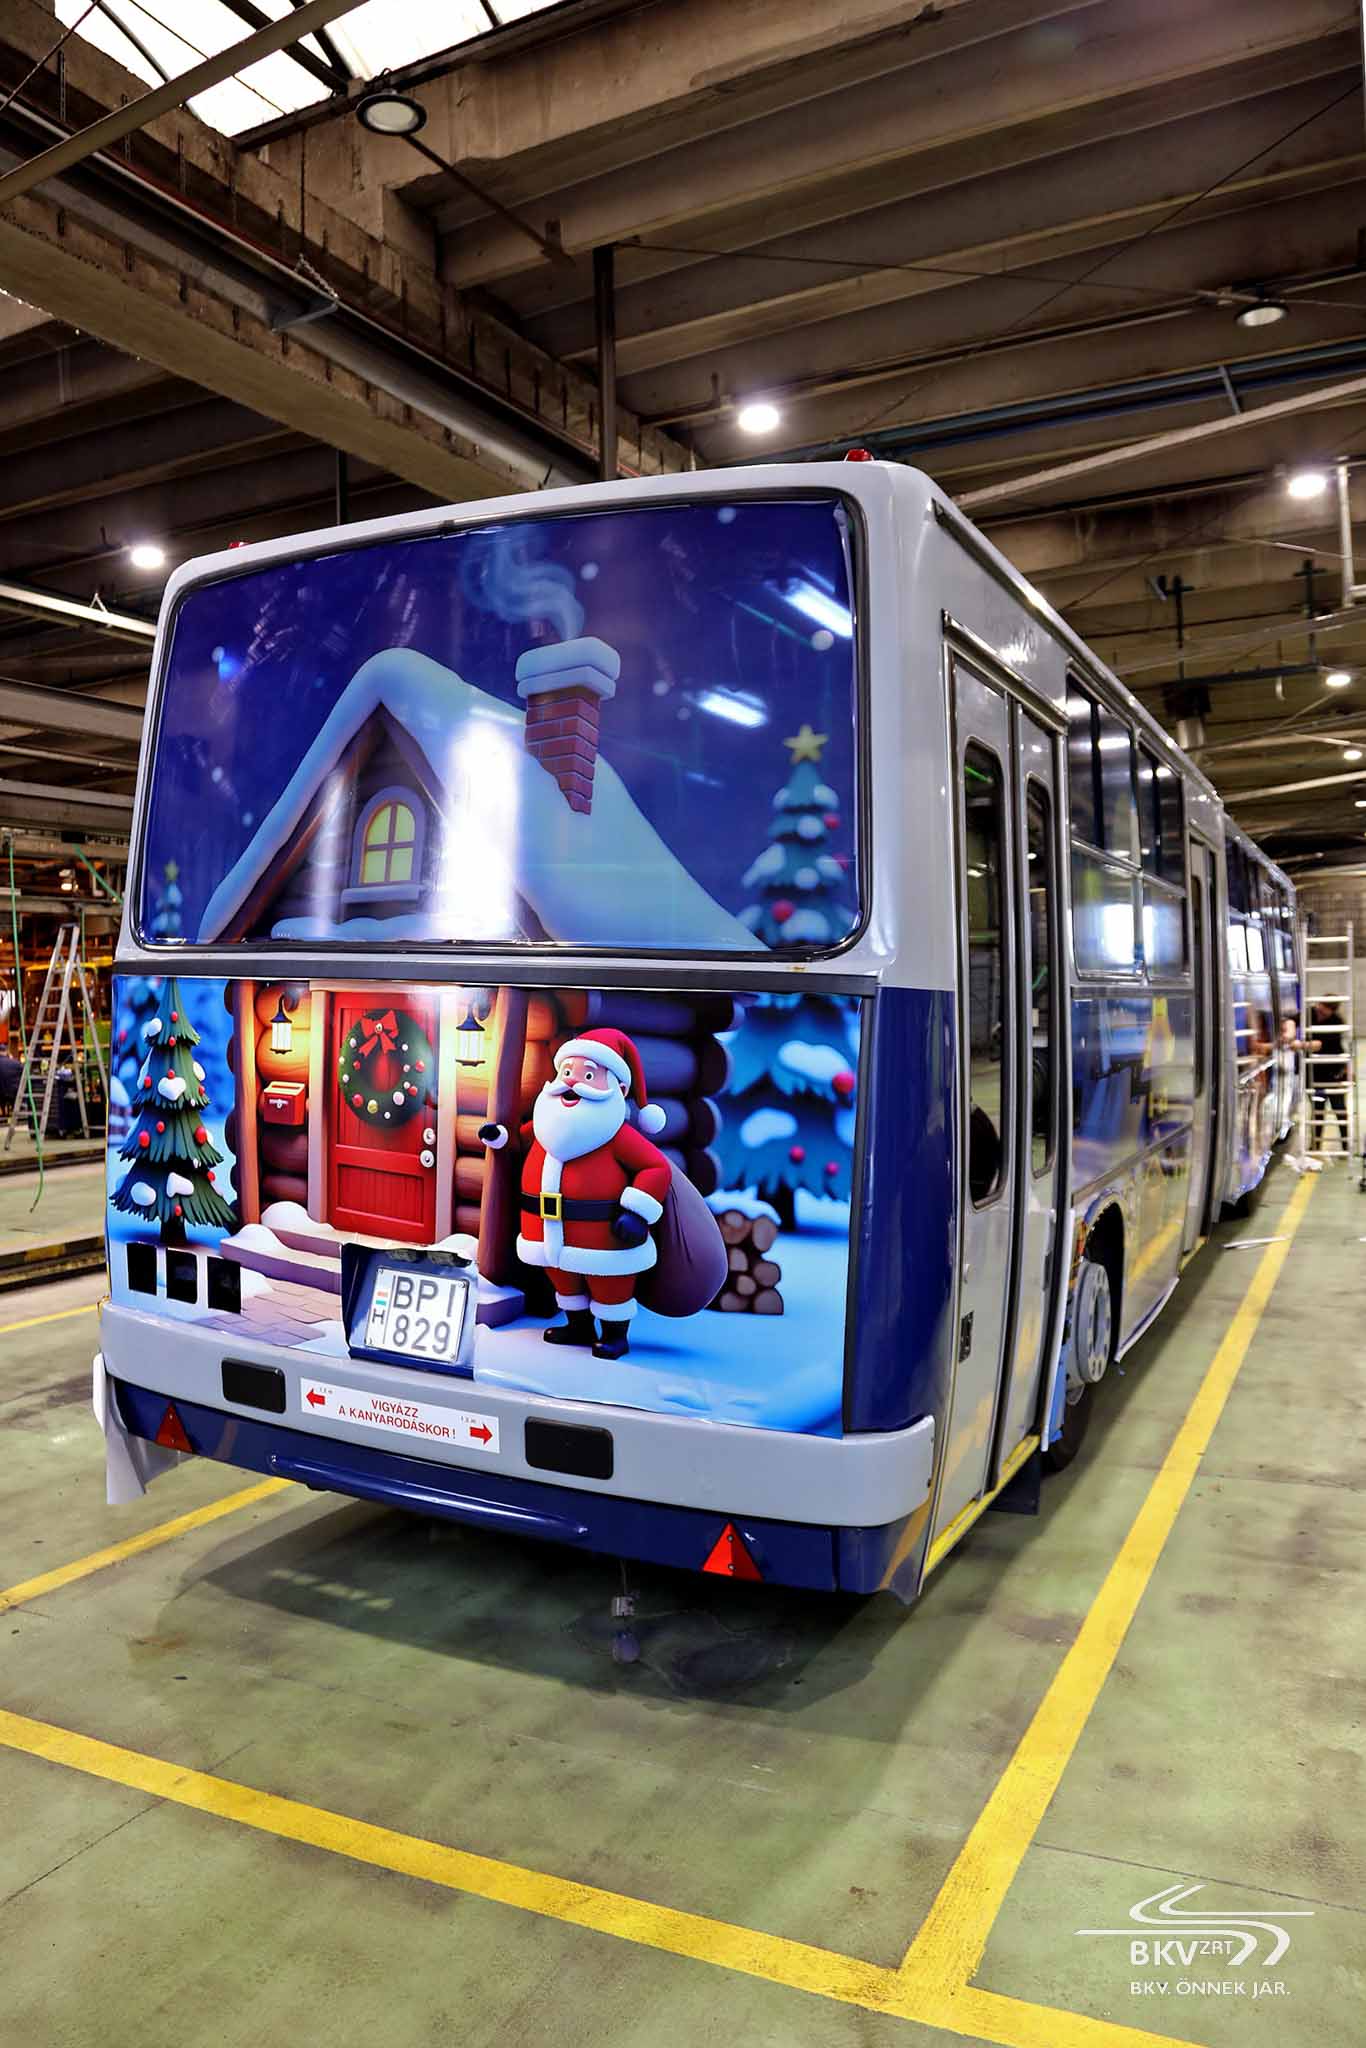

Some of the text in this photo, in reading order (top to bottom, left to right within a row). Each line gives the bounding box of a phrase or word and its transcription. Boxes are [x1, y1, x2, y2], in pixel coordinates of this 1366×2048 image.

[372, 1308, 386, 1325] H
[393, 1314, 450, 1355] 829
[338, 1404, 346, 1416] A
[371, 1398, 419, 1419] VIGYÁZZ
